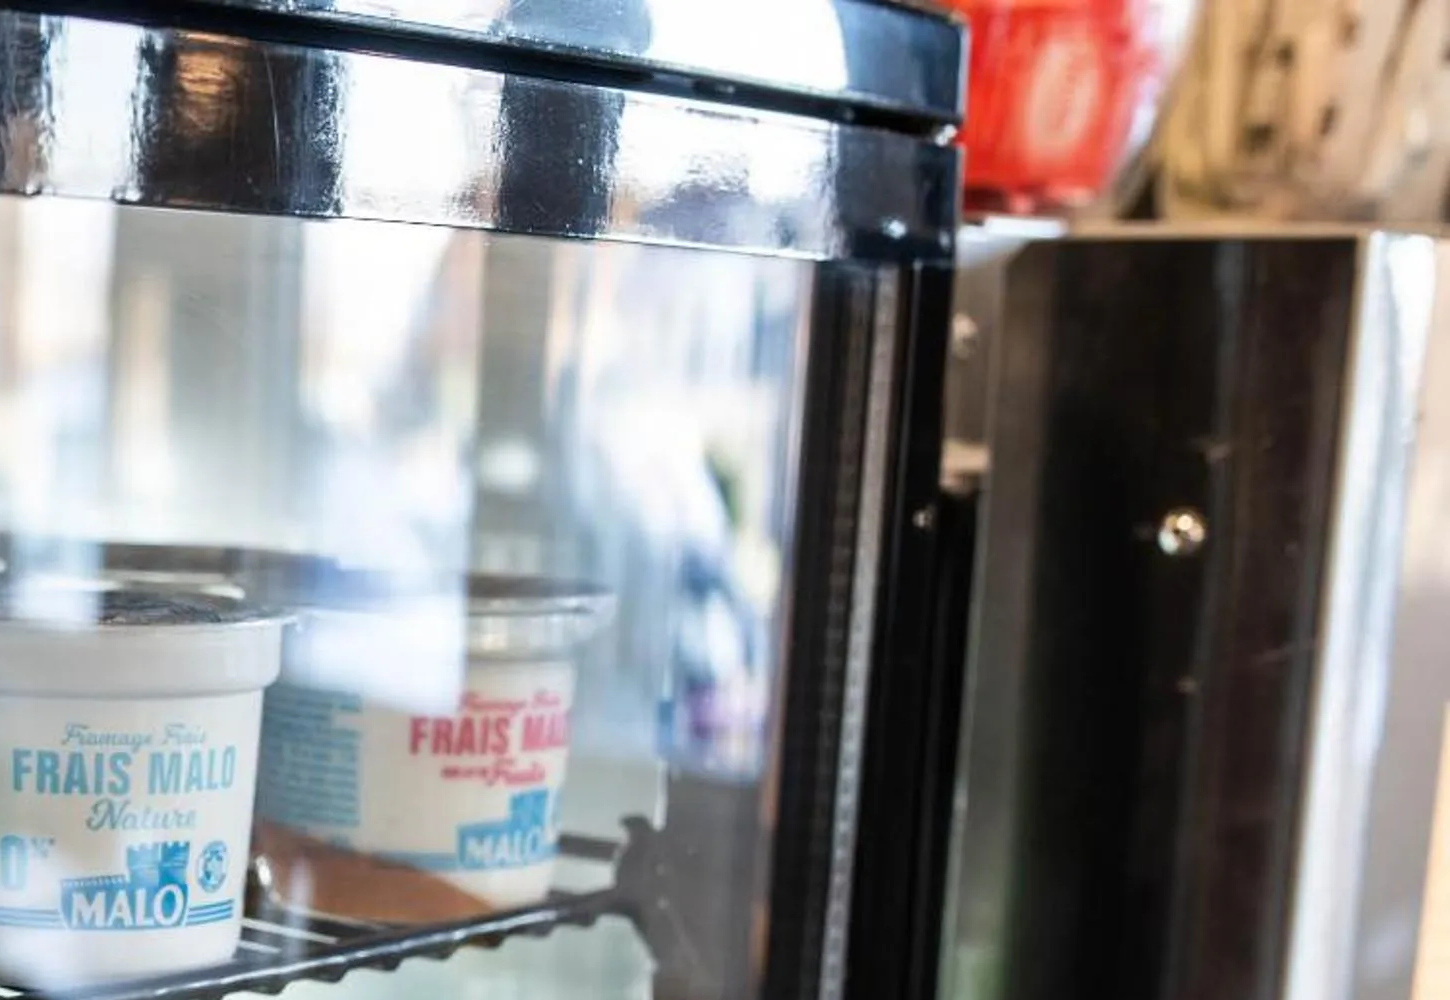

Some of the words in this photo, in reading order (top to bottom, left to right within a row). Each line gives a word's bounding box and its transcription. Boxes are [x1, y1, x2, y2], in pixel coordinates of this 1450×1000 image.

[61, 723, 152, 752] Fromage
[160, 722, 207, 746] Frais
[410, 714, 510, 757] FRAIS
[11, 747, 133, 796] FRAIS
[147, 744, 238, 796] MALO
[85, 798, 197, 832] Nature
[71, 885, 185, 929] MALO
